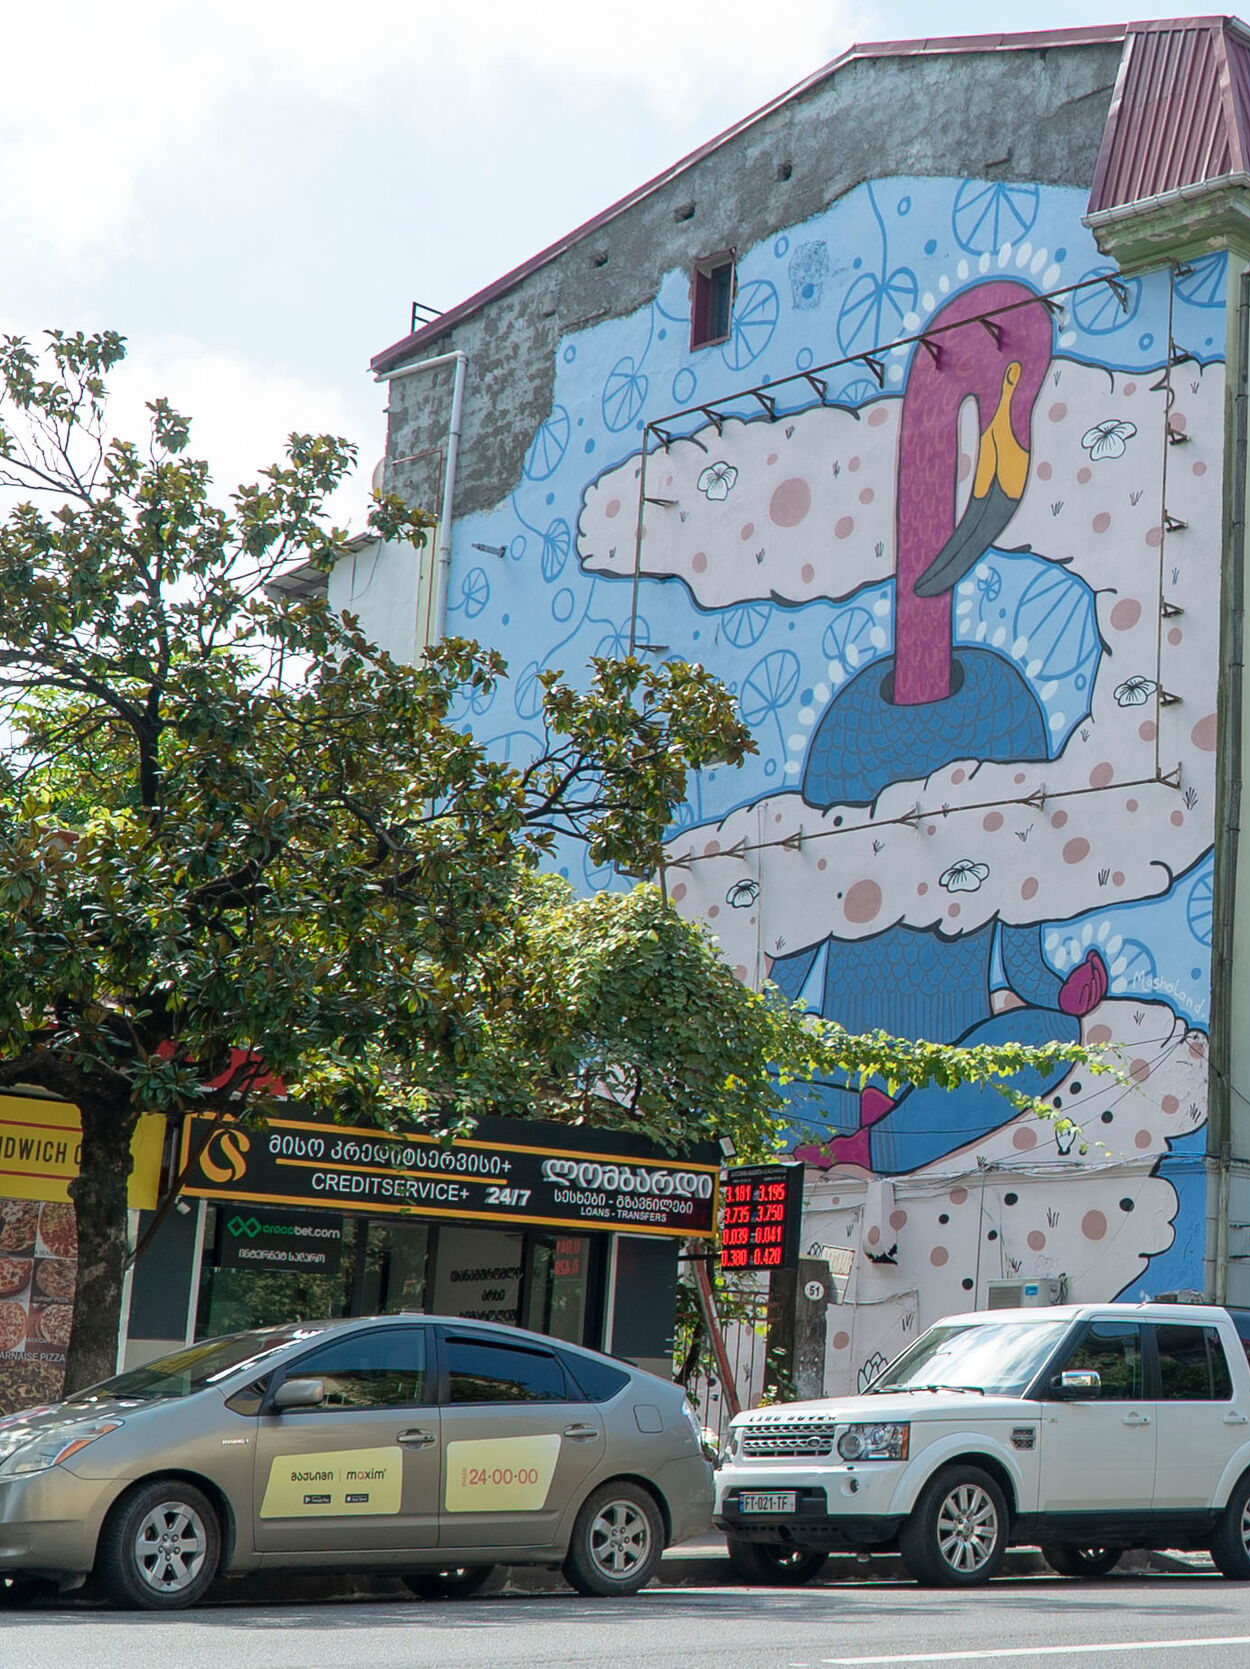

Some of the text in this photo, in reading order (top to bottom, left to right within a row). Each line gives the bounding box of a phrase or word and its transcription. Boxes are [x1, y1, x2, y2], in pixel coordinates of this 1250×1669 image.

[269, 1134, 325, 1158] მისო
[312, 1173, 470, 1201] CREDITSERVICE+
[541, 1159, 713, 1199] ლომბარდი
[484, 1187, 532, 1207] 24/7
[554, 1188, 606, 1205] სესხები
[580, 1206, 611, 1219] LOANS
[617, 1211, 668, 1223] TRANSFERS
[262, 1225, 341, 1239] crocobet.com
[809, 1285, 821, 1298] 51
[40, 1352, 66, 1362] PIZZA
[346, 1468, 385, 1480] maxim
